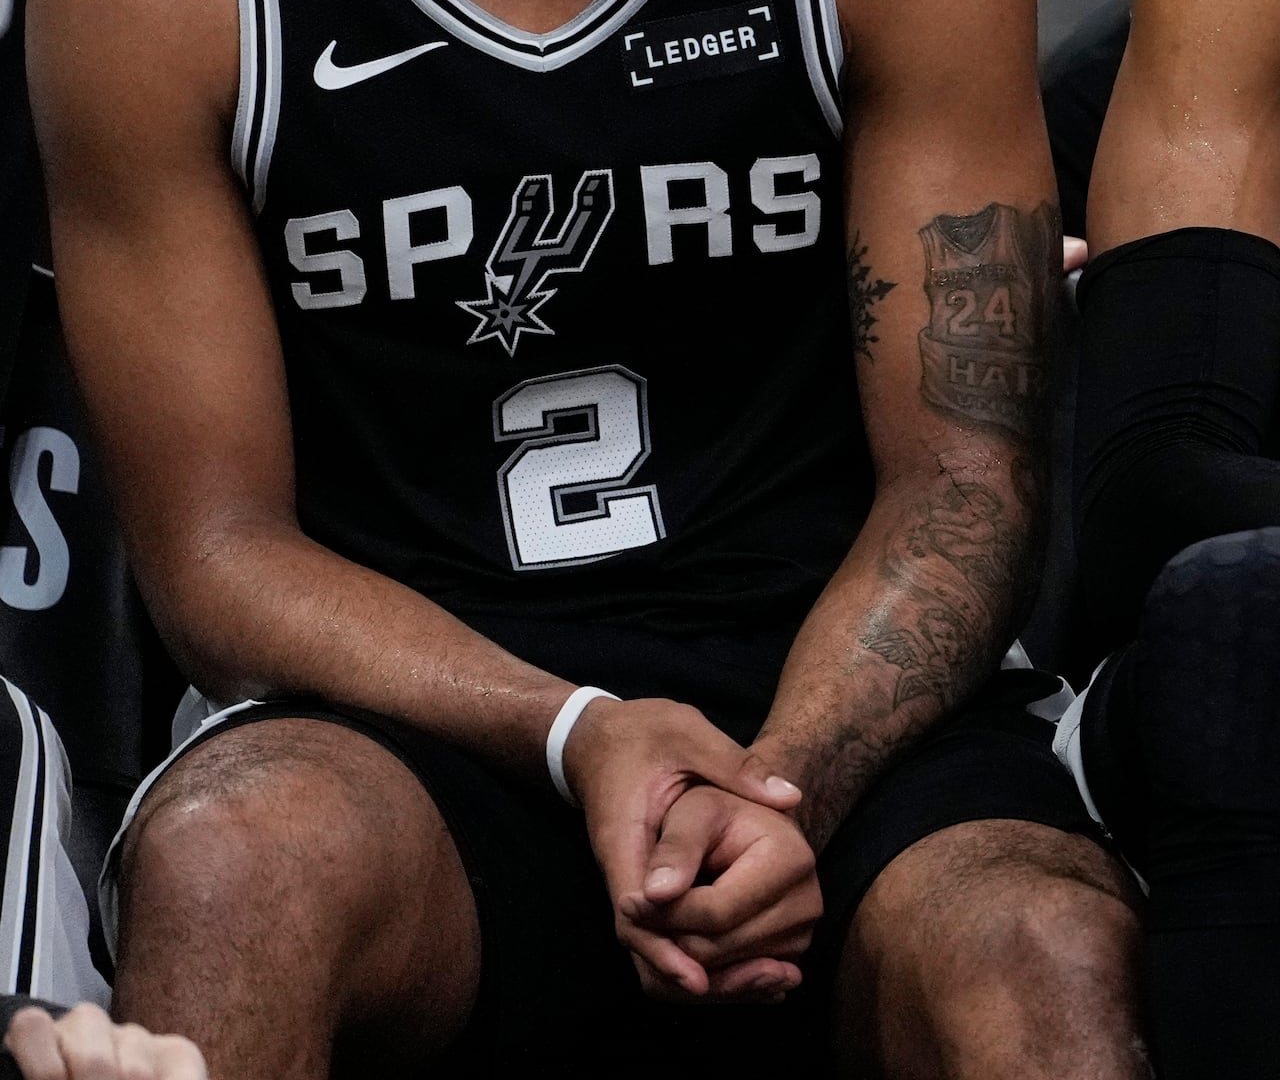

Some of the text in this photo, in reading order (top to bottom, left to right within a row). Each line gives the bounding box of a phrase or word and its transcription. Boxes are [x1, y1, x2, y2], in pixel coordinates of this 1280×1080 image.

[645, 25, 757, 69] LEDGER
[284, 153, 822, 357] SPURS
[945, 287, 1017, 336] 24
[493, 363, 667, 572] 2
